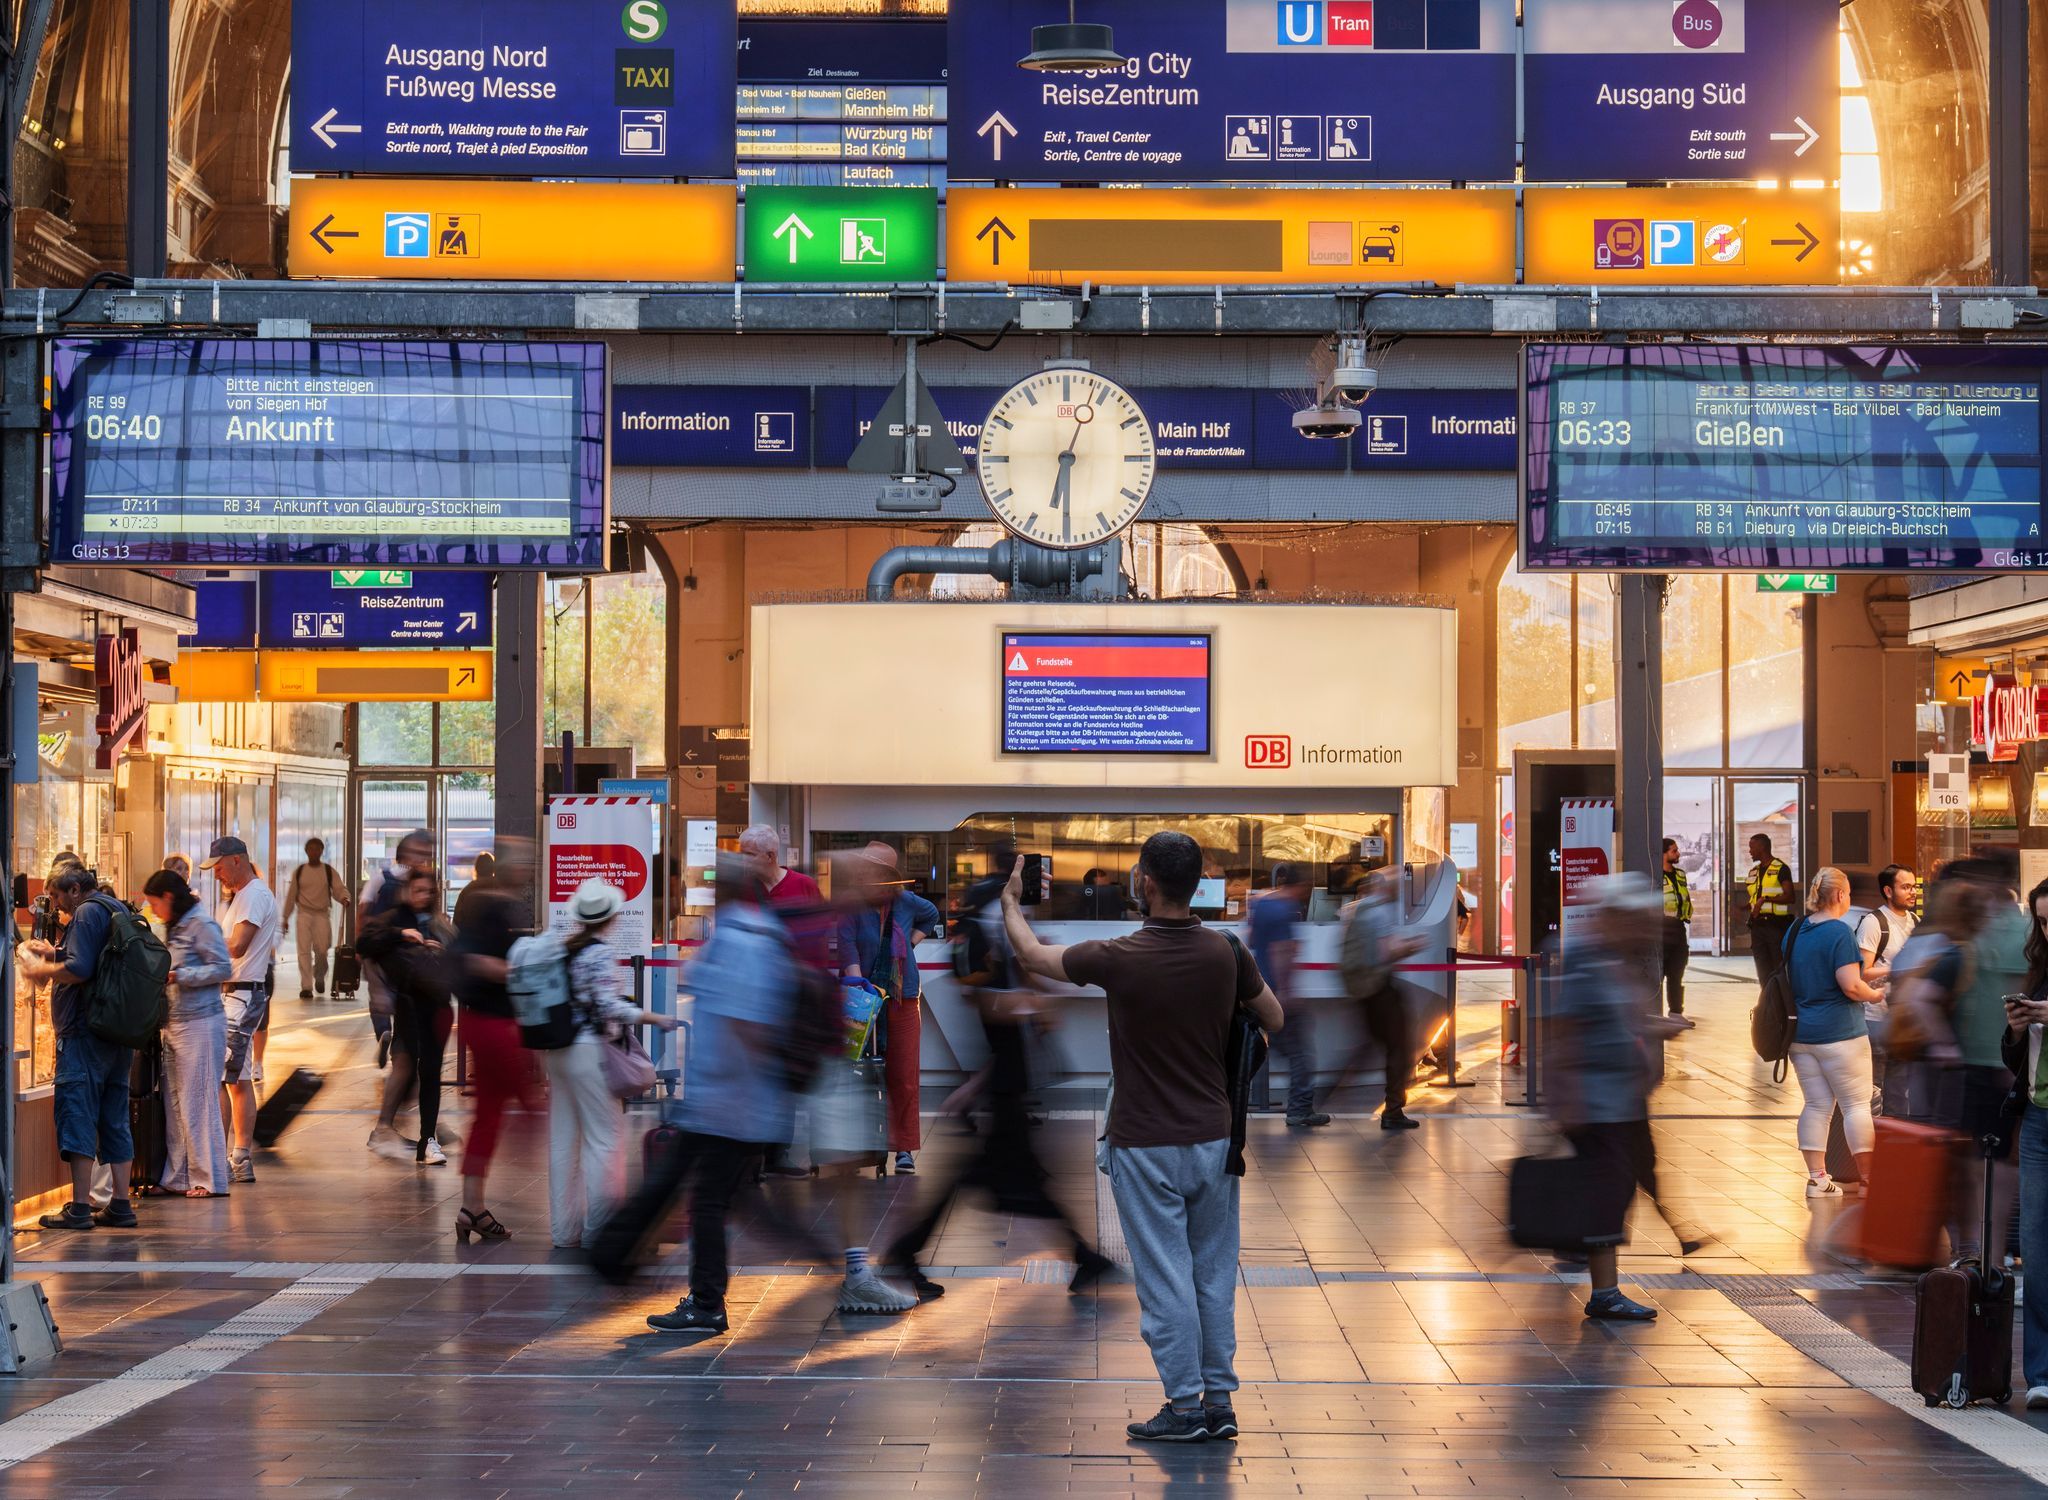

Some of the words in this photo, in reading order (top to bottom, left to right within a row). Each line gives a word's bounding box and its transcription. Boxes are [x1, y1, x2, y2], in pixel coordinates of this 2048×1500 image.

[629, 1, 660, 39] S
[1286, 5, 1314, 42] U
[1332, 16, 1369, 31] Tram
[1683, 16, 1712, 30] Bus
[385, 44, 484, 70] Ausgang
[493, 46, 547, 67] Nord
[808, 68, 823, 76] Ziel
[1149, 52, 1191, 78] City
[622, 67, 669, 88] TAXI
[386, 75, 474, 102] Fußweg
[483, 78, 556, 98] Messe
[742, 89, 758, 98] Bad
[791, 89, 806, 98] Bad
[808, 90, 841, 98] Nauheim
[845, 88, 886, 100] Gießen
[1043, 84, 1199, 105] ReiseZentrum
[1597, 84, 1694, 109] Ausgang
[1703, 83, 1745, 104] Süd
[845, 104, 908, 117] Mannheim
[913, 105, 934, 117] Hbf
[386, 123, 411, 135] Exit
[414, 123, 445, 137] north,
[448, 123, 494, 138] Walking
[496, 124, 526, 136] route
[529, 125, 541, 136] to
[544, 124, 562, 136] the
[565, 124, 588, 137] Fair
[762, 129, 776, 137] Hbf
[845, 127, 907, 142] Würzburg
[912, 127, 932, 140] Hbf
[1044, 131, 1066, 143] Exit
[1076, 131, 1109, 143] Travel
[1113, 131, 1150, 143] Center
[1690, 131, 1711, 141] Exit
[1715, 130, 1745, 141] south
[386, 141, 420, 154] Sortie
[422, 142, 452, 156] nord,
[456, 142, 488, 157] Trajet
[490, 142, 498, 154] à
[500, 143, 526, 157] pied
[529, 143, 588, 157] Exposition
[845, 144, 868, 156] Bad
[871, 143, 905, 158] König
[1688, 149, 1721, 159] Sortie
[1725, 148, 1745, 159] sud
[1044, 150, 1079, 163] Sortie,
[1084, 150, 1124, 163] Centre
[1128, 150, 1139, 162] de
[1142, 152, 1181, 164] voyage
[762, 168, 776, 176] Hbf
[845, 167, 893, 179] Laufach
[399, 226, 419, 254] P
[1654, 224, 1681, 263] P
[226, 379, 259, 391] Bitte
[265, 378, 299, 391] nicht
[305, 379, 374, 394] einsteigen
[89, 396, 104, 408] RE
[110, 396, 126, 408] 99
[227, 400, 250, 410] von
[257, 398, 300, 412] Siegen
[306, 398, 327, 410] Hbf
[1560, 402, 1574, 414] RB
[1581, 402, 1596, 414] 37
[1834, 403, 1857, 415] Bad
[1863, 403, 1900, 416] Vilbel
[1917, 403, 1940, 416] Bad
[1947, 404, 2001, 416] Nauheim
[87, 415, 160, 440] 06:40
[621, 411, 730, 430] Information
[1432, 416, 1515, 434] Informati
[226, 415, 335, 441] Ankunft
[1158, 423, 1197, 438] Main
[1202, 423, 1230, 438] Hbf
[1559, 420, 1631, 445] 06:33
[1696, 421, 1783, 446] Gießen
[1174, 447, 1180, 455] de
[123, 499, 158, 511] 07:11
[224, 500, 239, 512] RB
[245, 500, 260, 512] 34
[274, 500, 328, 512] Ankunft
[335, 503, 359, 513] von
[364, 501, 501, 515] Glauburg-Stockheim
[1596, 504, 1631, 516] 06:45
[1696, 505, 1711, 516] RB
[1717, 505, 1732, 516] 34
[1745, 505, 1799, 517] Ankunft
[1807, 507, 1829, 517] von
[1836, 505, 1971, 519] Glauburg-Stockheim
[122, 517, 158, 529] 07:23
[1596, 522, 1631, 534] 07:15
[1696, 522, 1711, 534] RB
[1717, 522, 1732, 534] 61
[1745, 522, 1795, 537] Dieburg
[1808, 523, 1826, 534] via
[1833, 523, 1948, 535] Dreieich-Buchsch
[2030, 524, 2038, 535] A
[72, 545, 109, 558] Gleis
[114, 545, 130, 558] 13
[1994, 552, 2031, 566] Gleis
[361, 596, 443, 609] ReiseZentrum
[391, 630, 411, 638] Centre
[412, 630, 421, 638] de
[422, 631, 443, 639] voyage
[1995, 685, 2039, 743] CROBAG
[1251, 741, 1285, 762] DB
[1302, 744, 1401, 763] Information
[1939, 795, 1958, 804] 106
